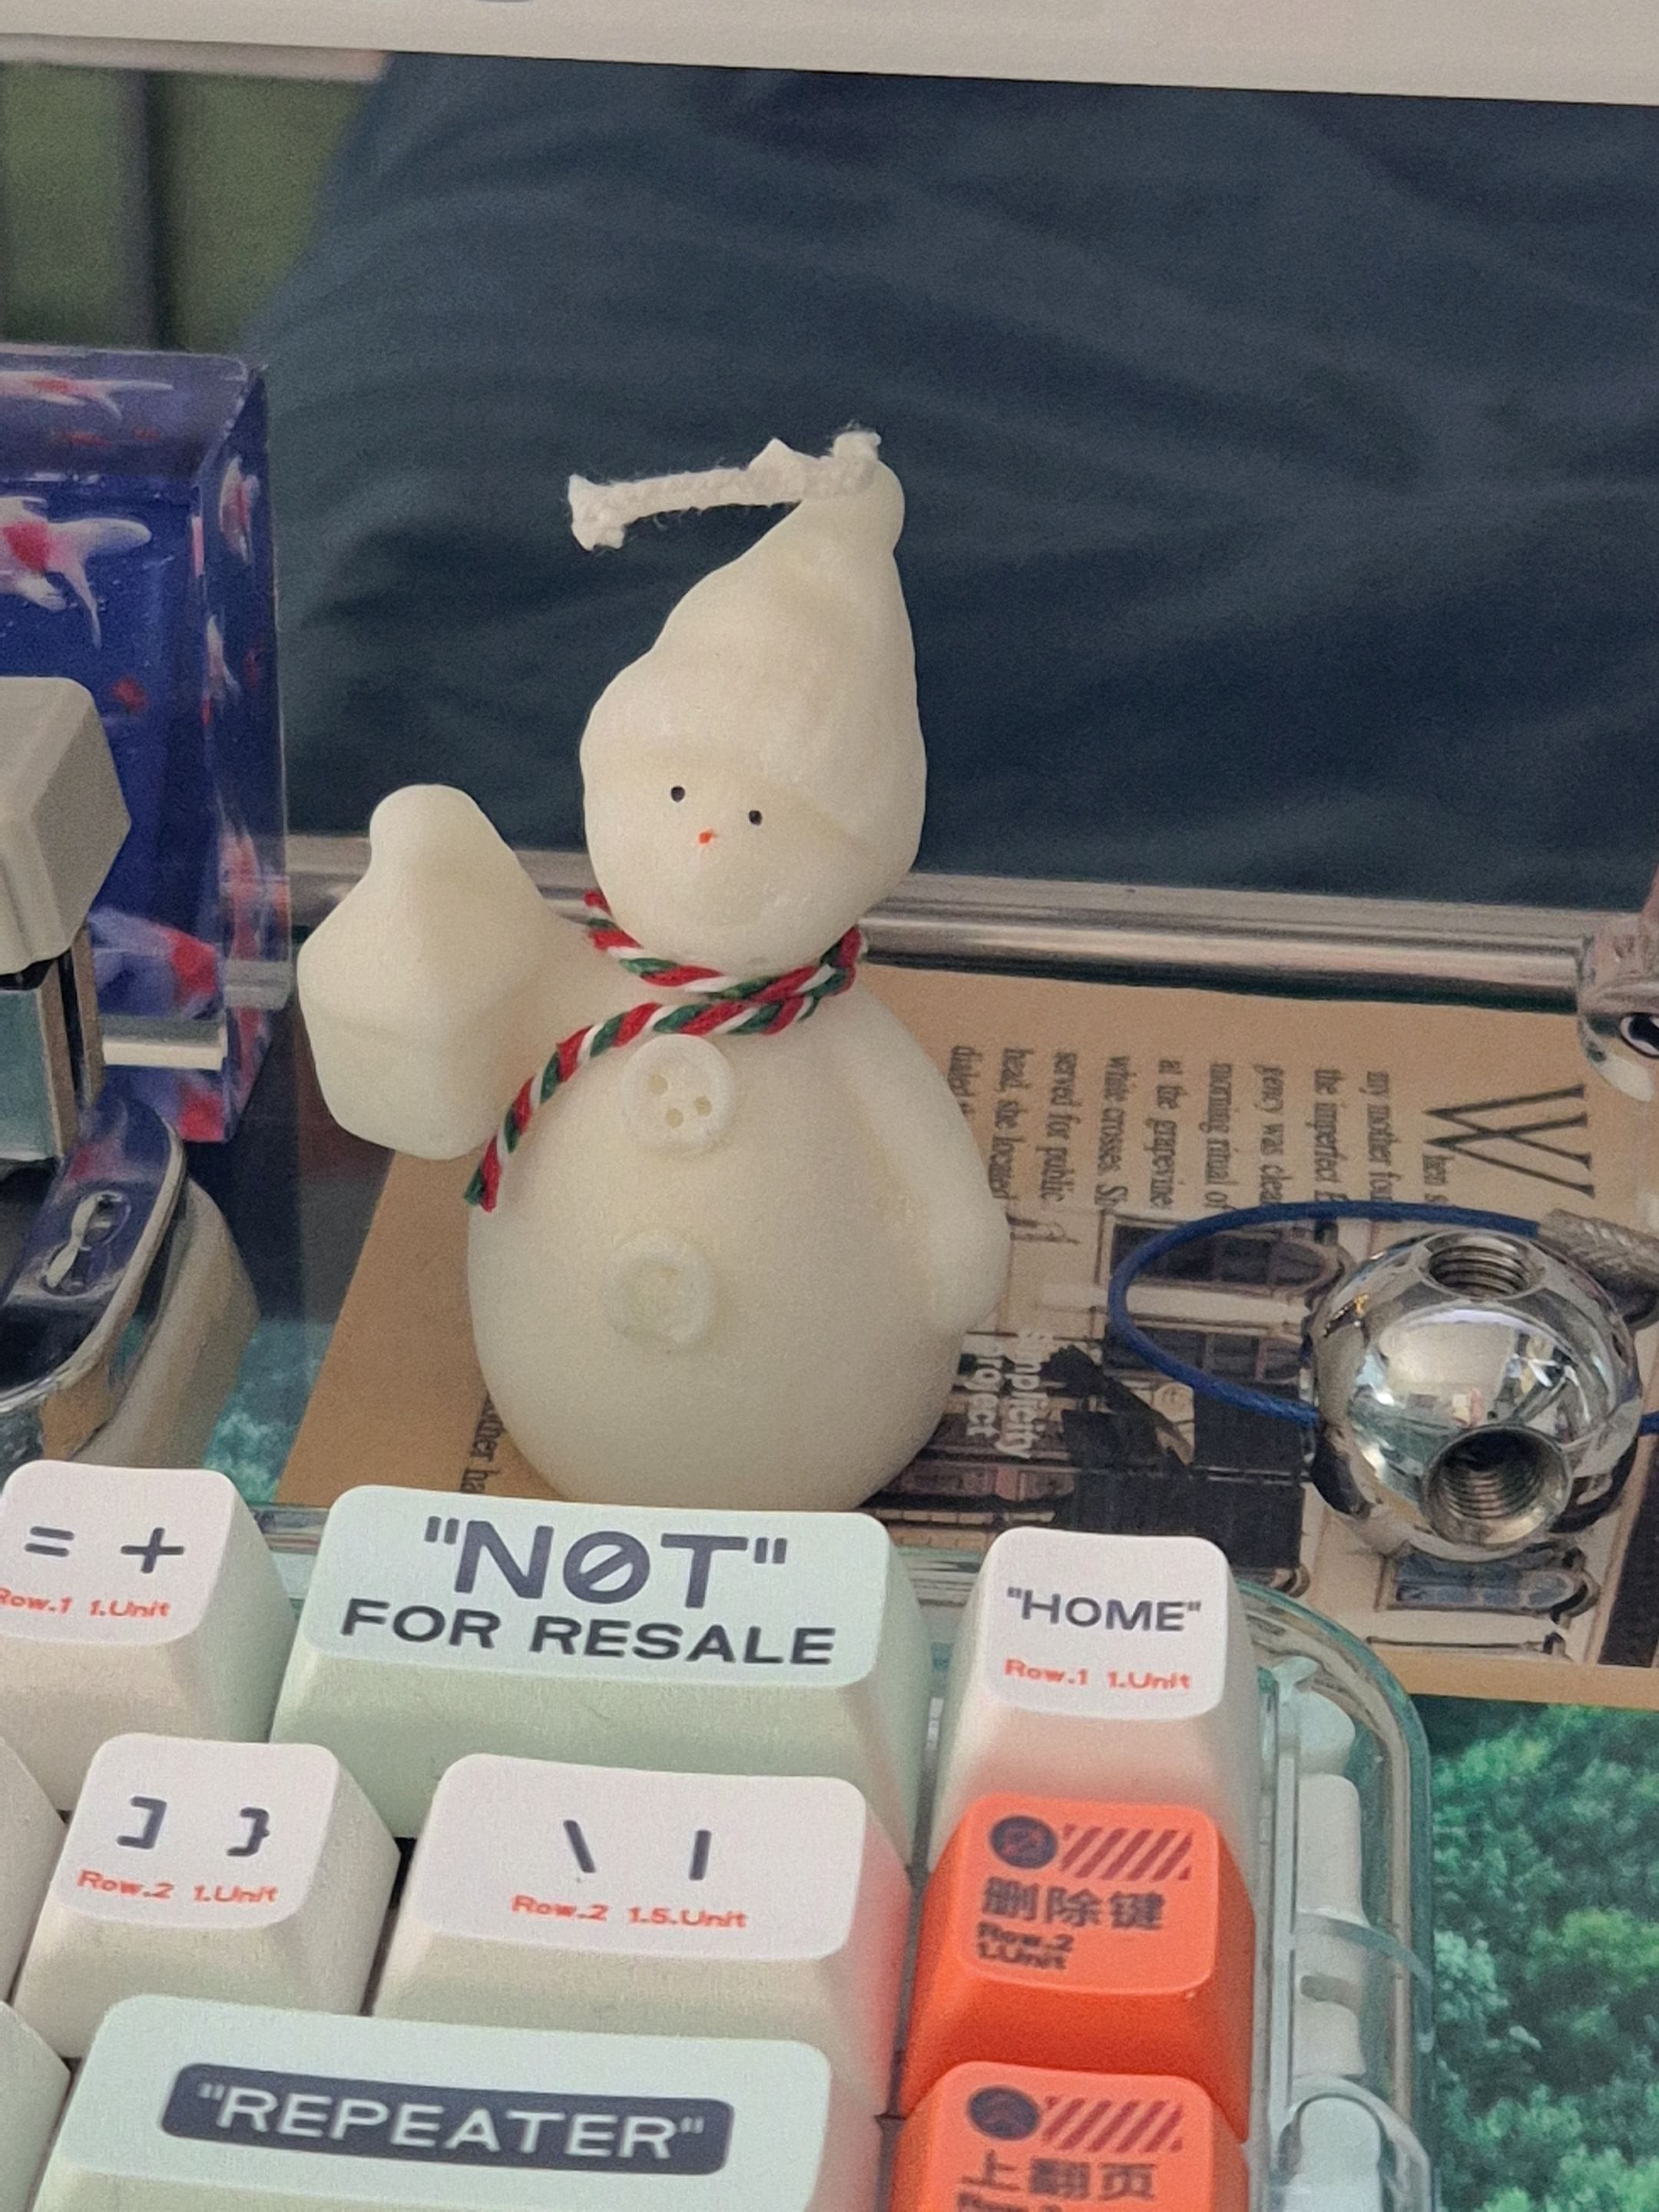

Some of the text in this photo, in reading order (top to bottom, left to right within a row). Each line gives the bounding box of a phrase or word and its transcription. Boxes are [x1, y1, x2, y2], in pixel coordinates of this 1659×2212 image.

[1104, 1055, 1137, 1103] white
[1157, 1085, 1188, 1110] the
[1200, 1063, 1240, 1134] morning
[1314, 1068, 1346, 1094] the
[1045, 1113, 1081, 1140] for
[1260, 1123, 1284, 1156] was
[1305, 1102, 1349, 1183] imperfect
[1367, 1104, 1399, 1164] mother
[1035, 1147, 1076, 1203] public
[1205, 1138, 1240, 1185] ritual
[340, 1598, 837, 1665] FOR RESALE
[1006, 1586, 1202, 1631] "HOME"
[1004, 1657, 1090, 1687] Row.1
[78, 1869, 174, 1900] Row.2
[511, 1894, 609, 1922] Row.2
[197, 2081, 705, 2160] "REPEATER"
[960, 2148, 1157, 2201] 上翻页
